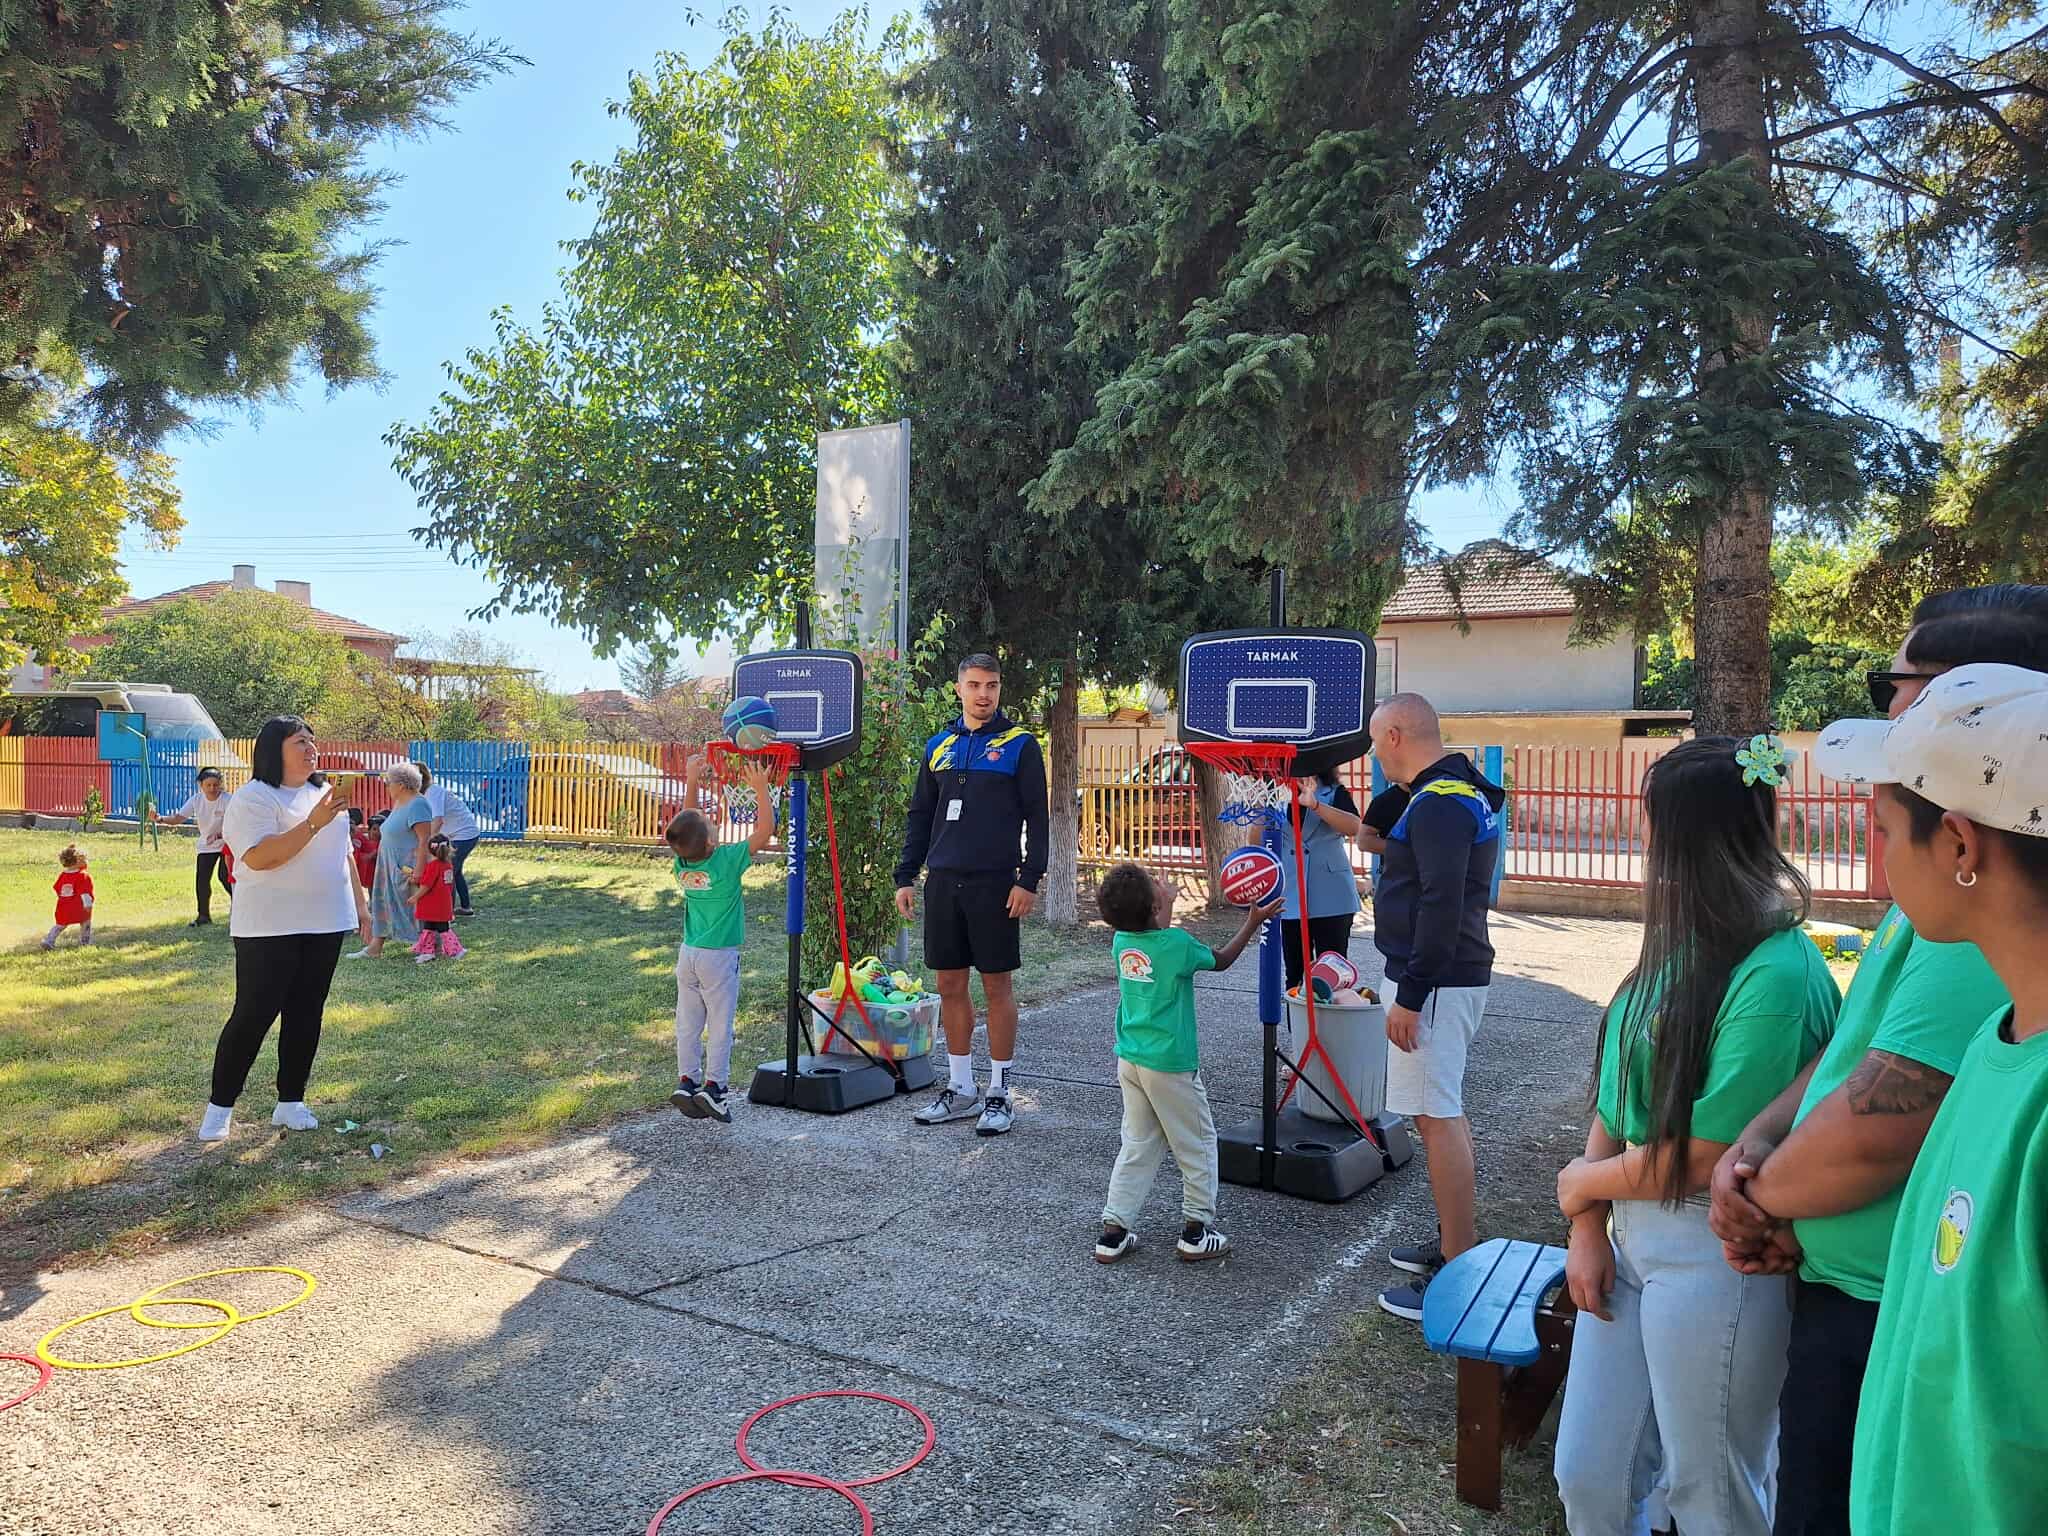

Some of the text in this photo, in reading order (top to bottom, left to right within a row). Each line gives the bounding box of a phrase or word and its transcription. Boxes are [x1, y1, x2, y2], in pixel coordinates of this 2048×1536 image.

[1246, 651, 1299, 662] TARMAK
[776, 669, 812, 678] TARMAK
[2012, 824, 2046, 834] POLO
[788, 817, 798, 875] TARMAK
[1234, 880, 1269, 900] TARMAK
